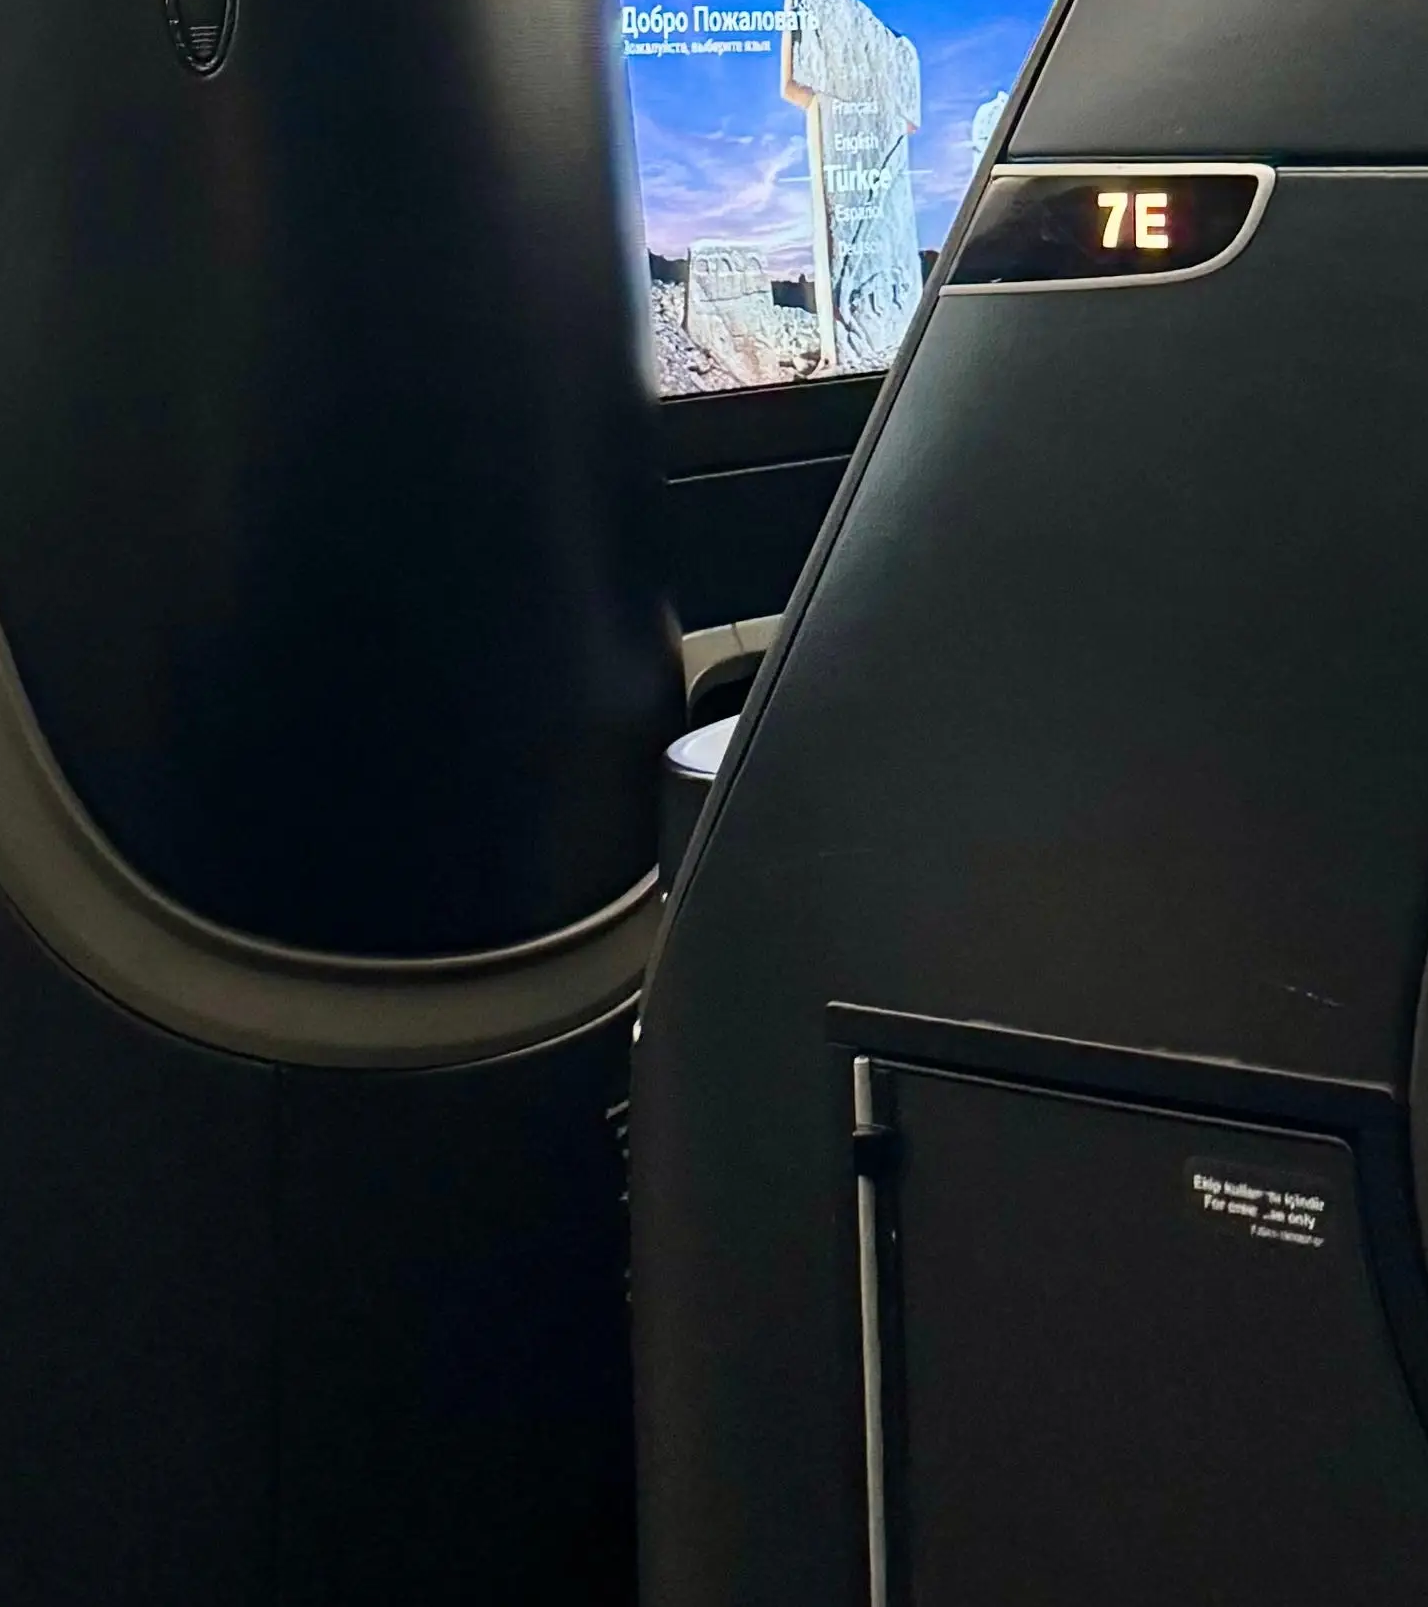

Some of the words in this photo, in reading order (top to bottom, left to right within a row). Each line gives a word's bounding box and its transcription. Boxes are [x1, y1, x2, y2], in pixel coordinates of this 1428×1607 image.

[622, 4, 689, 39] Добро
[693, 5, 820, 32] Пожаловать
[834, 131, 879, 154] English
[1097, 192, 1169, 249] 7E
[1204, 1194, 1226, 1211] For
[1287, 1212, 1316, 1231] only
